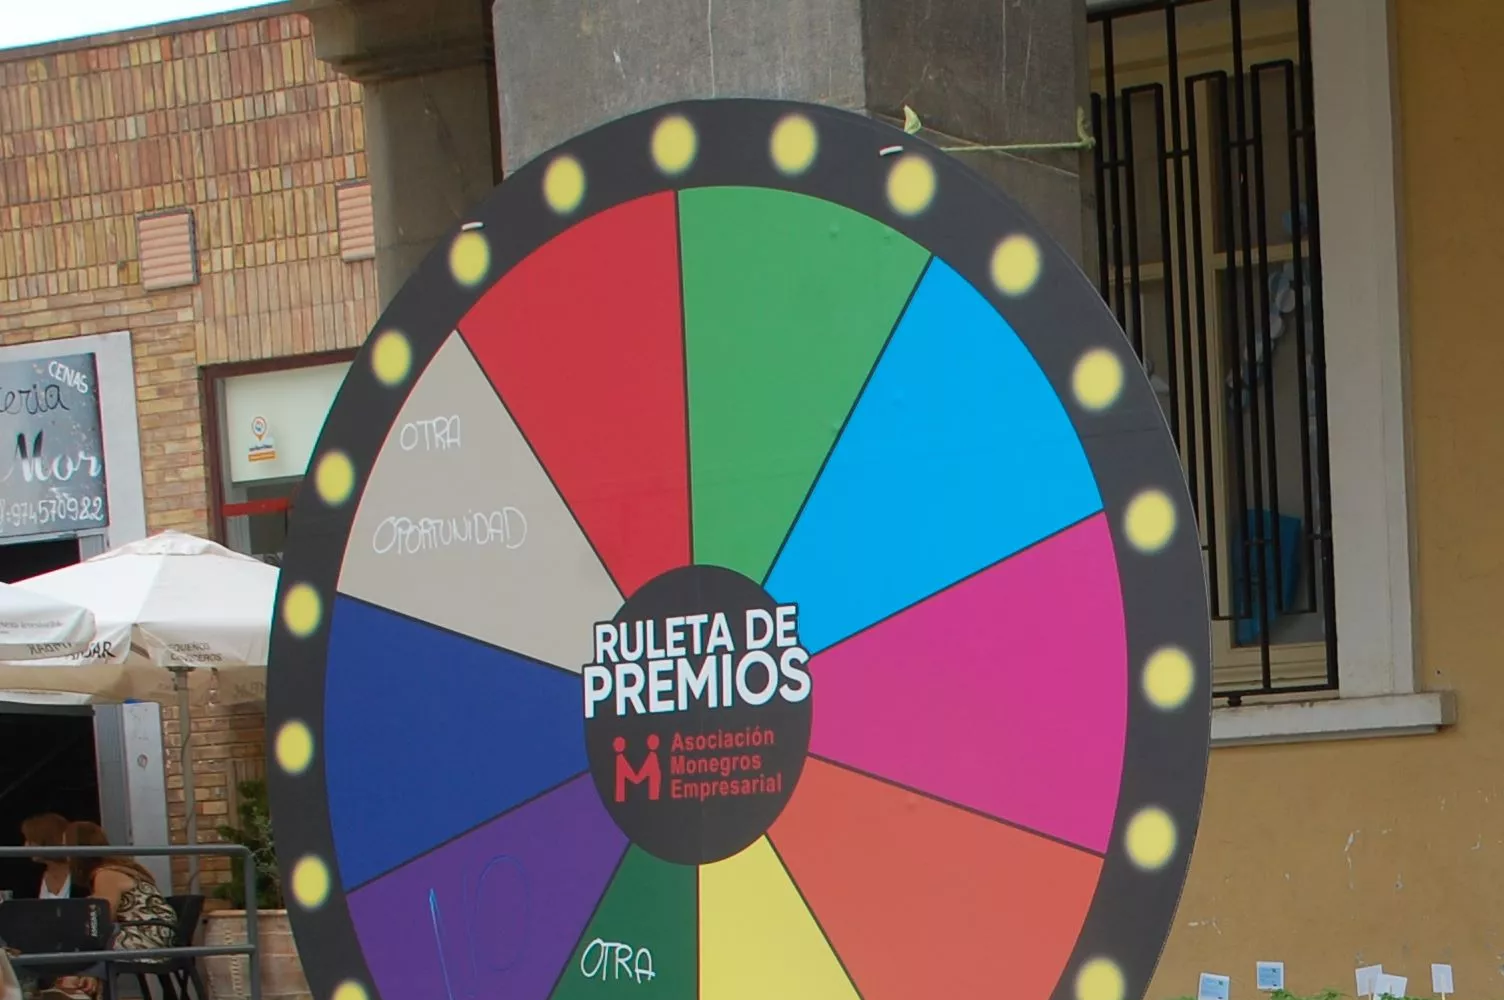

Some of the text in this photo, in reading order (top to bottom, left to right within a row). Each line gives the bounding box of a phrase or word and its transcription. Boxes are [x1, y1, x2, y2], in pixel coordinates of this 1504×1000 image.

[48, 361, 88, 394] CENAS
[0, 384, 69, 415] eria
[400, 415, 460, 450] OTRA
[595, 605, 798, 664] RULETA DE
[584, 647, 811, 718] PREMIOS
[670, 726, 775, 752] Asociación
[671, 753, 762, 777] Monegros
[671, 772, 782, 801] Empresarial
[581, 938, 655, 984] OTRA
